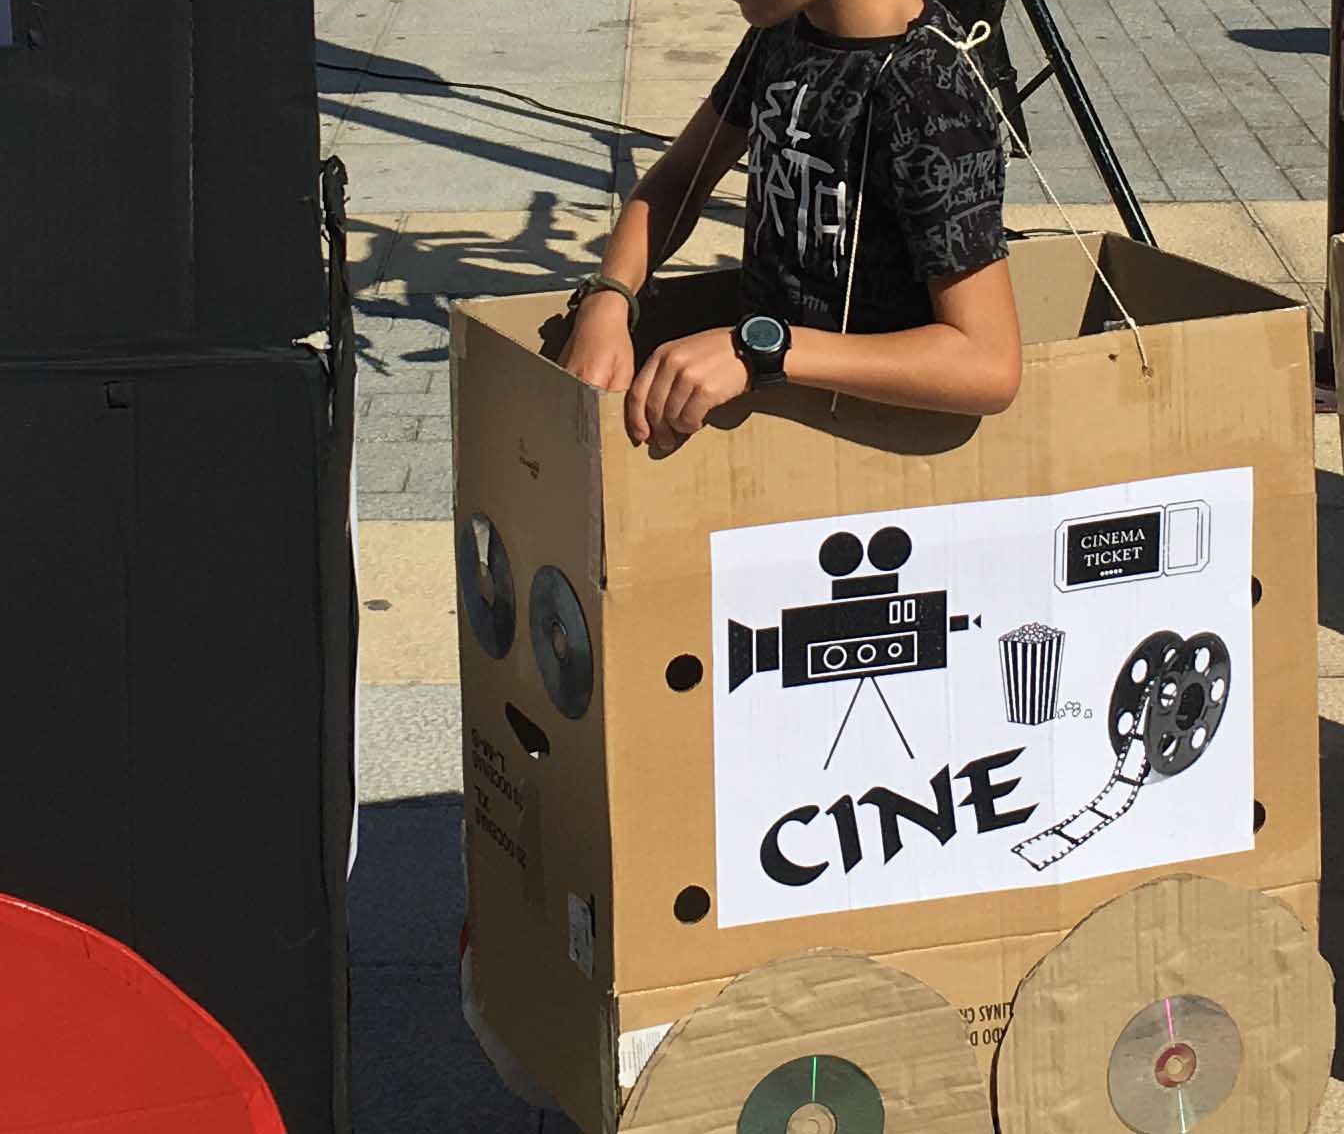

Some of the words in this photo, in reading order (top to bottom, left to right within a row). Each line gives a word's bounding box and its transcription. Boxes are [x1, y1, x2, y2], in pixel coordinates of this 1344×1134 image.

[1080, 528, 1146, 549] CINEMA
[1083, 546, 1143, 567] TICKET
[759, 746, 1040, 887] CINE
